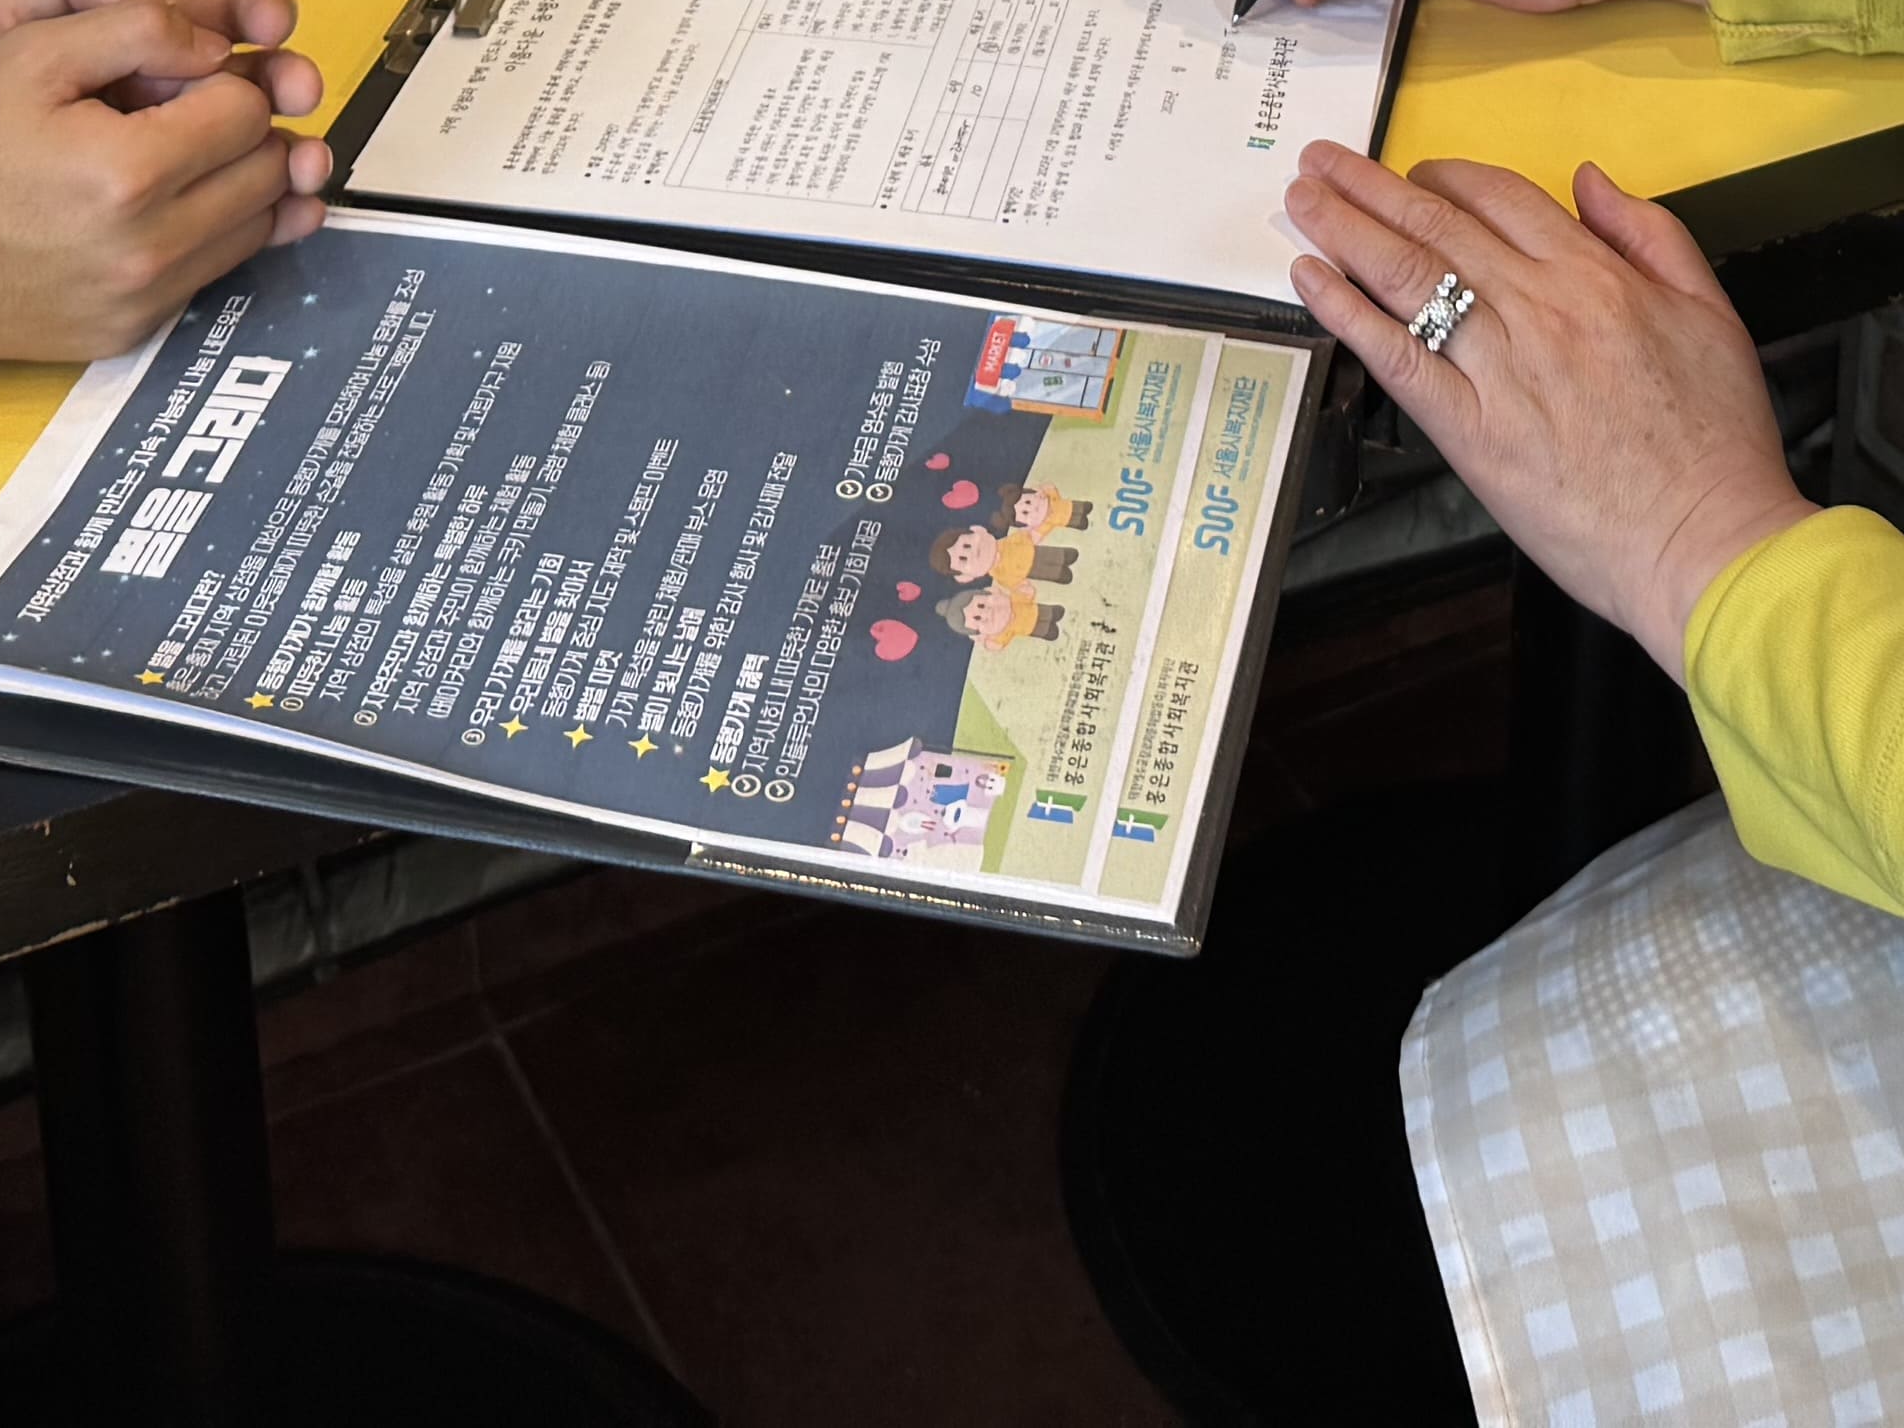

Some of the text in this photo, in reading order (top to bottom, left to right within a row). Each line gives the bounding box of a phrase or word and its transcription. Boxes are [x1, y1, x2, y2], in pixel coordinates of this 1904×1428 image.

[178, 356, 217, 386] 나눔
[149, 387, 197, 433] 가능한
[1125, 360, 1170, 461] 서울시복지재단
[97, 352, 295, 581] 별을 그리다
[127, 434, 169, 467] 지속
[94, 467, 147, 515] 만드는
[421, 471, 455, 501] 활동
[74, 516, 115, 549] 함께
[403, 502, 439, 532] 후원
[387, 532, 423, 565] 살린
[16, 550, 95, 621] 지역상점과
[358, 483, 491, 708] 지역주민과 함께하는 특별한 하루
[286, 577, 369, 697] 따뜻한 나눔 활동
[314, 666, 352, 700] 지역
[1063, 641, 1115, 786] 홍은종합사회복지관
[1144, 660, 1199, 805] 홍은종합사회복지관
